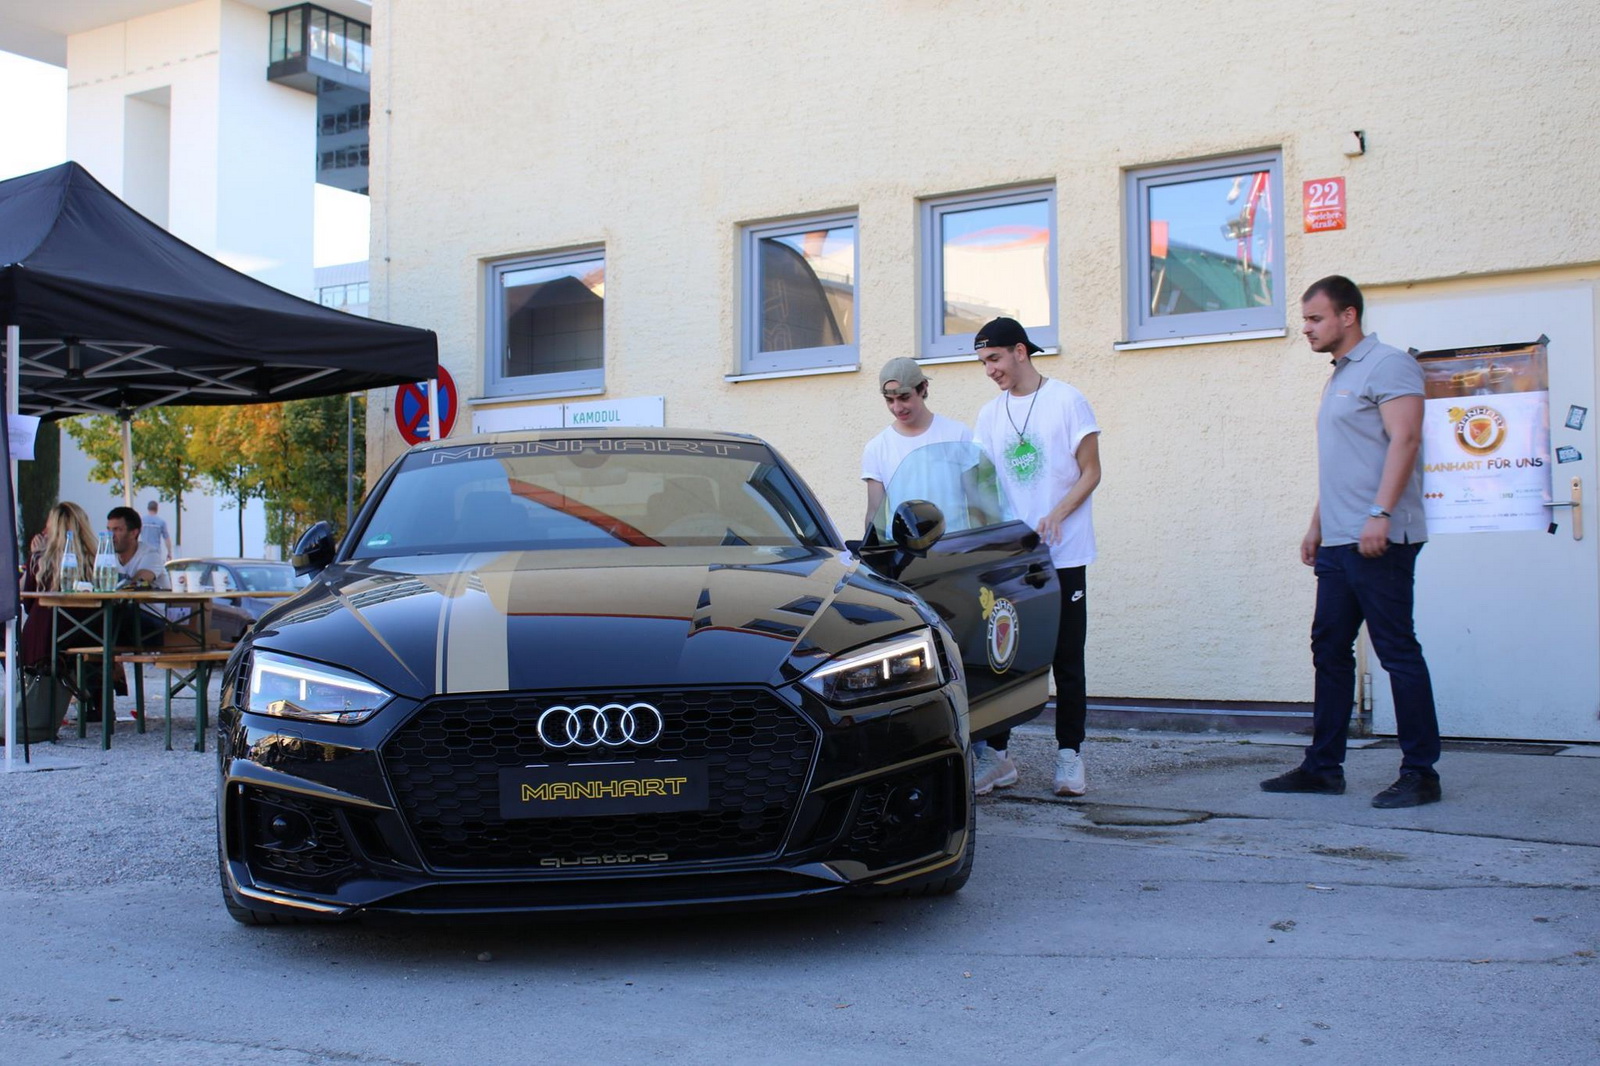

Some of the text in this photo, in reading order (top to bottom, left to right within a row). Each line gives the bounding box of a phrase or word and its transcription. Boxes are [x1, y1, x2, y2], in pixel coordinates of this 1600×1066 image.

[1309, 181, 1339, 208] 22
[572, 409, 621, 424] KAMODUL
[431, 439, 741, 465] MANHART
[1487, 457, 1510, 469] FÜR
[1516, 457, 1543, 469] UNS
[521, 776, 688, 802] MANHART
[540, 851, 669, 868] quattro
